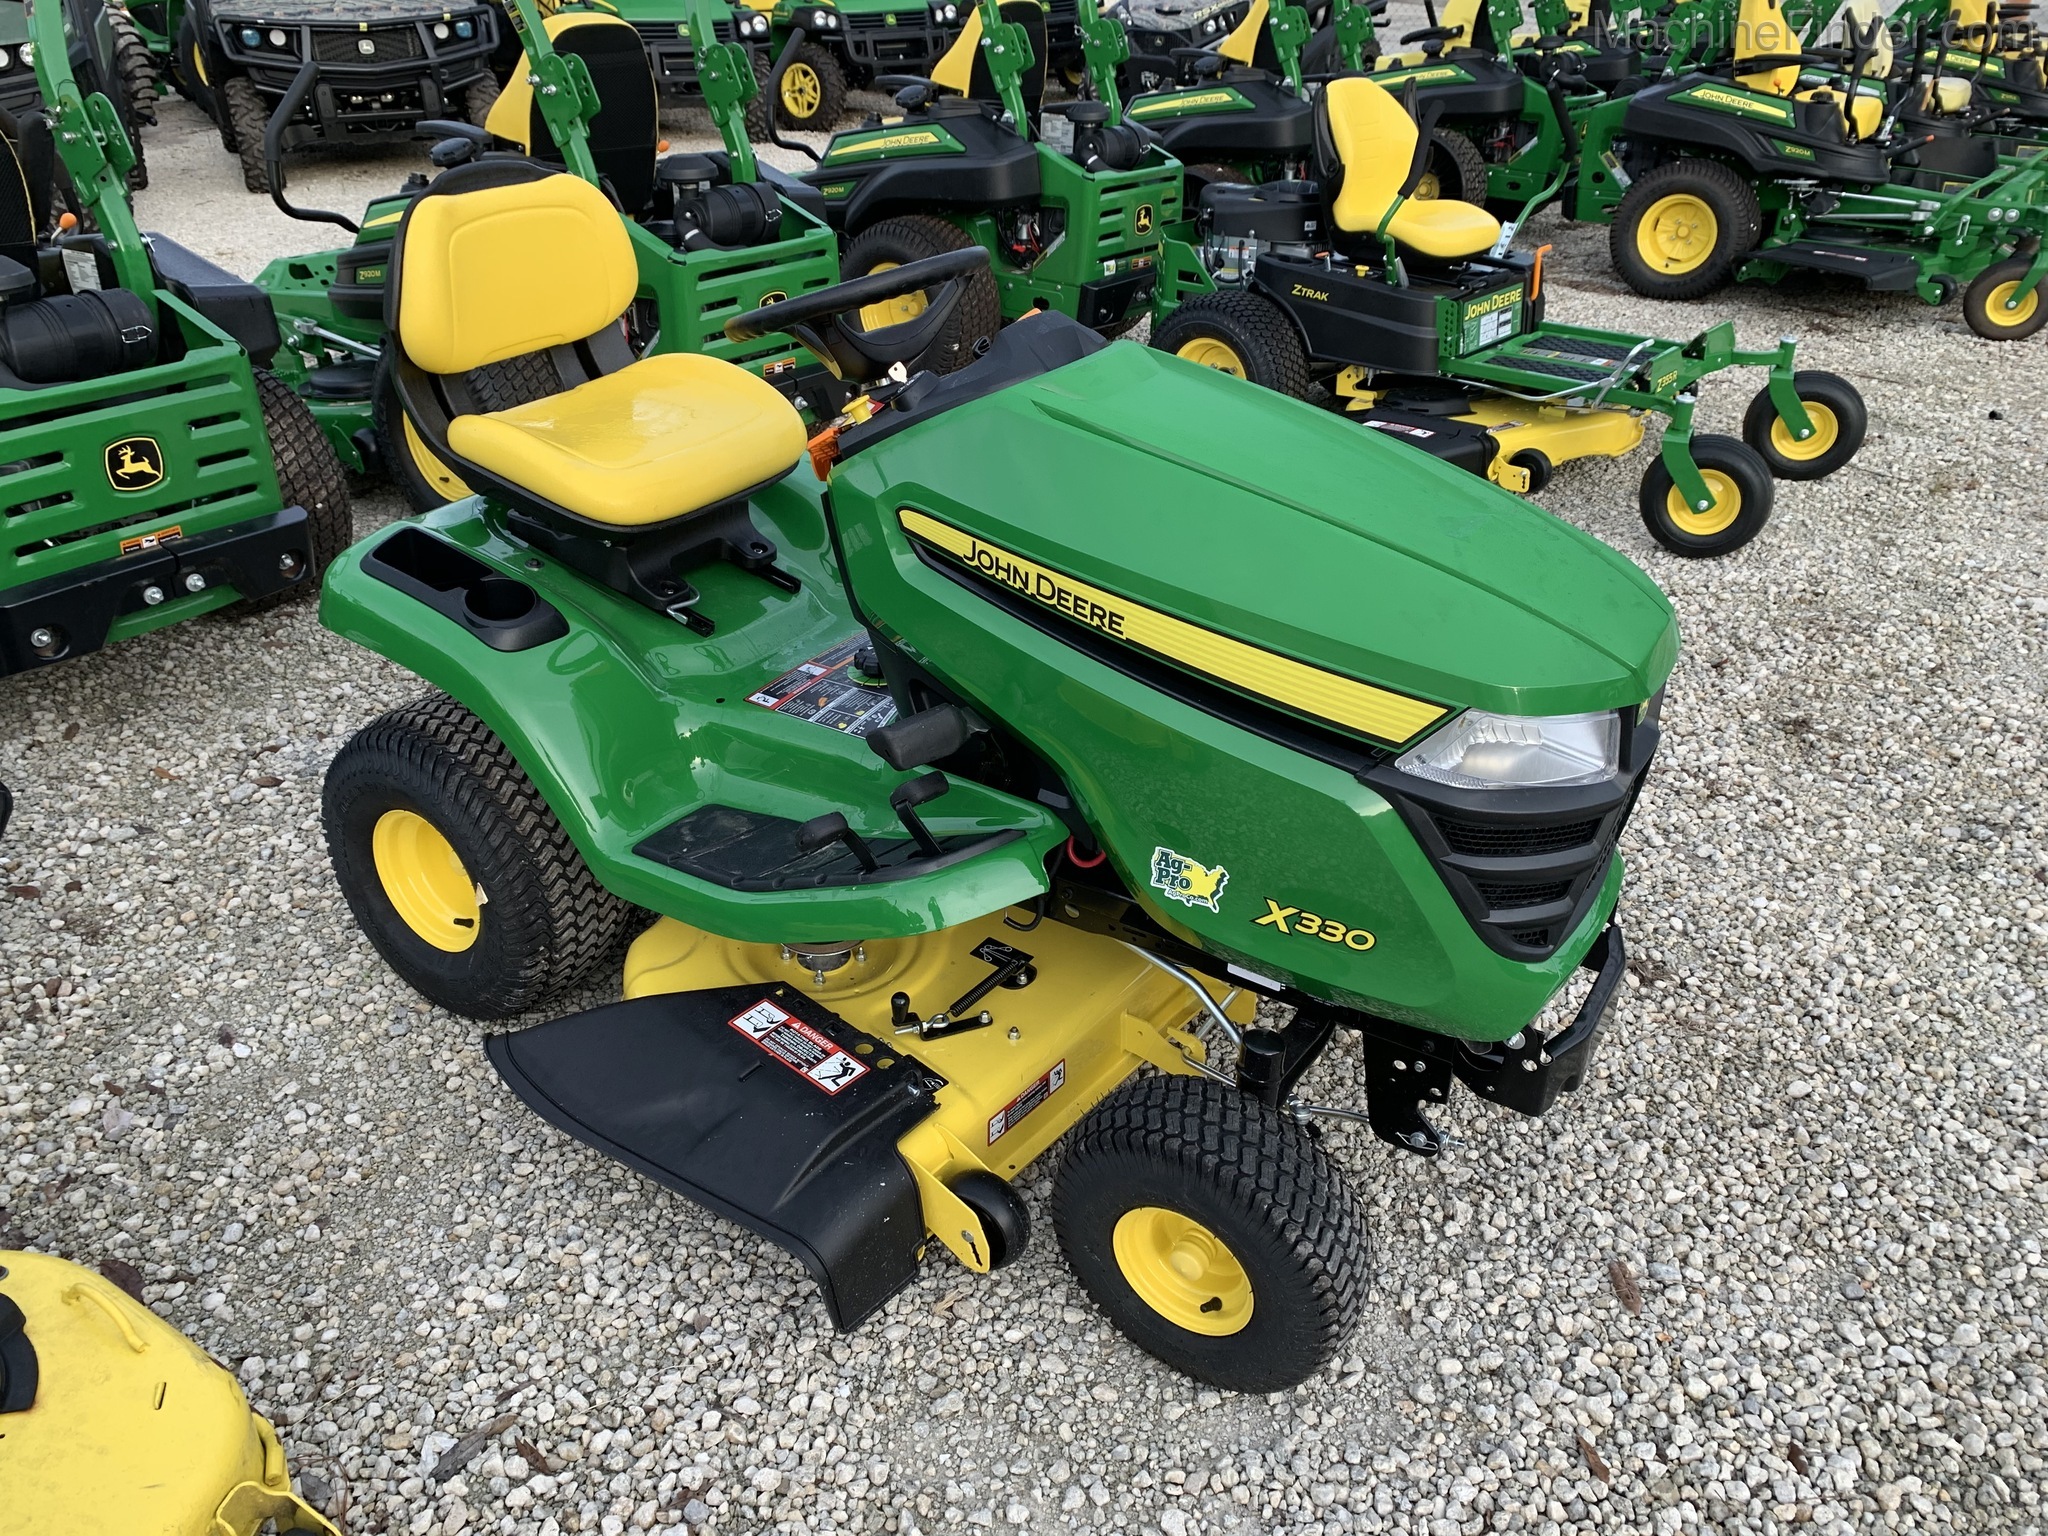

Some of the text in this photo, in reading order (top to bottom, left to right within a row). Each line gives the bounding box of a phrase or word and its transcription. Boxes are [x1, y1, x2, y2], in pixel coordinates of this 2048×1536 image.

[1701, 90, 1755, 109] JOHN DEERE
[881, 135, 930, 148] JOHN DEERE
[1291, 283, 1330, 302] ZTRAK
[1464, 287, 1523, 321] JOHN DEERE
[961, 539, 1126, 637] JOHN DEERE
[1156, 851, 1191, 875] Ag-
[1155, 867, 1191, 890] Pro
[1252, 897, 1377, 951] X330
[799, 1026, 834, 1050] DANGER
